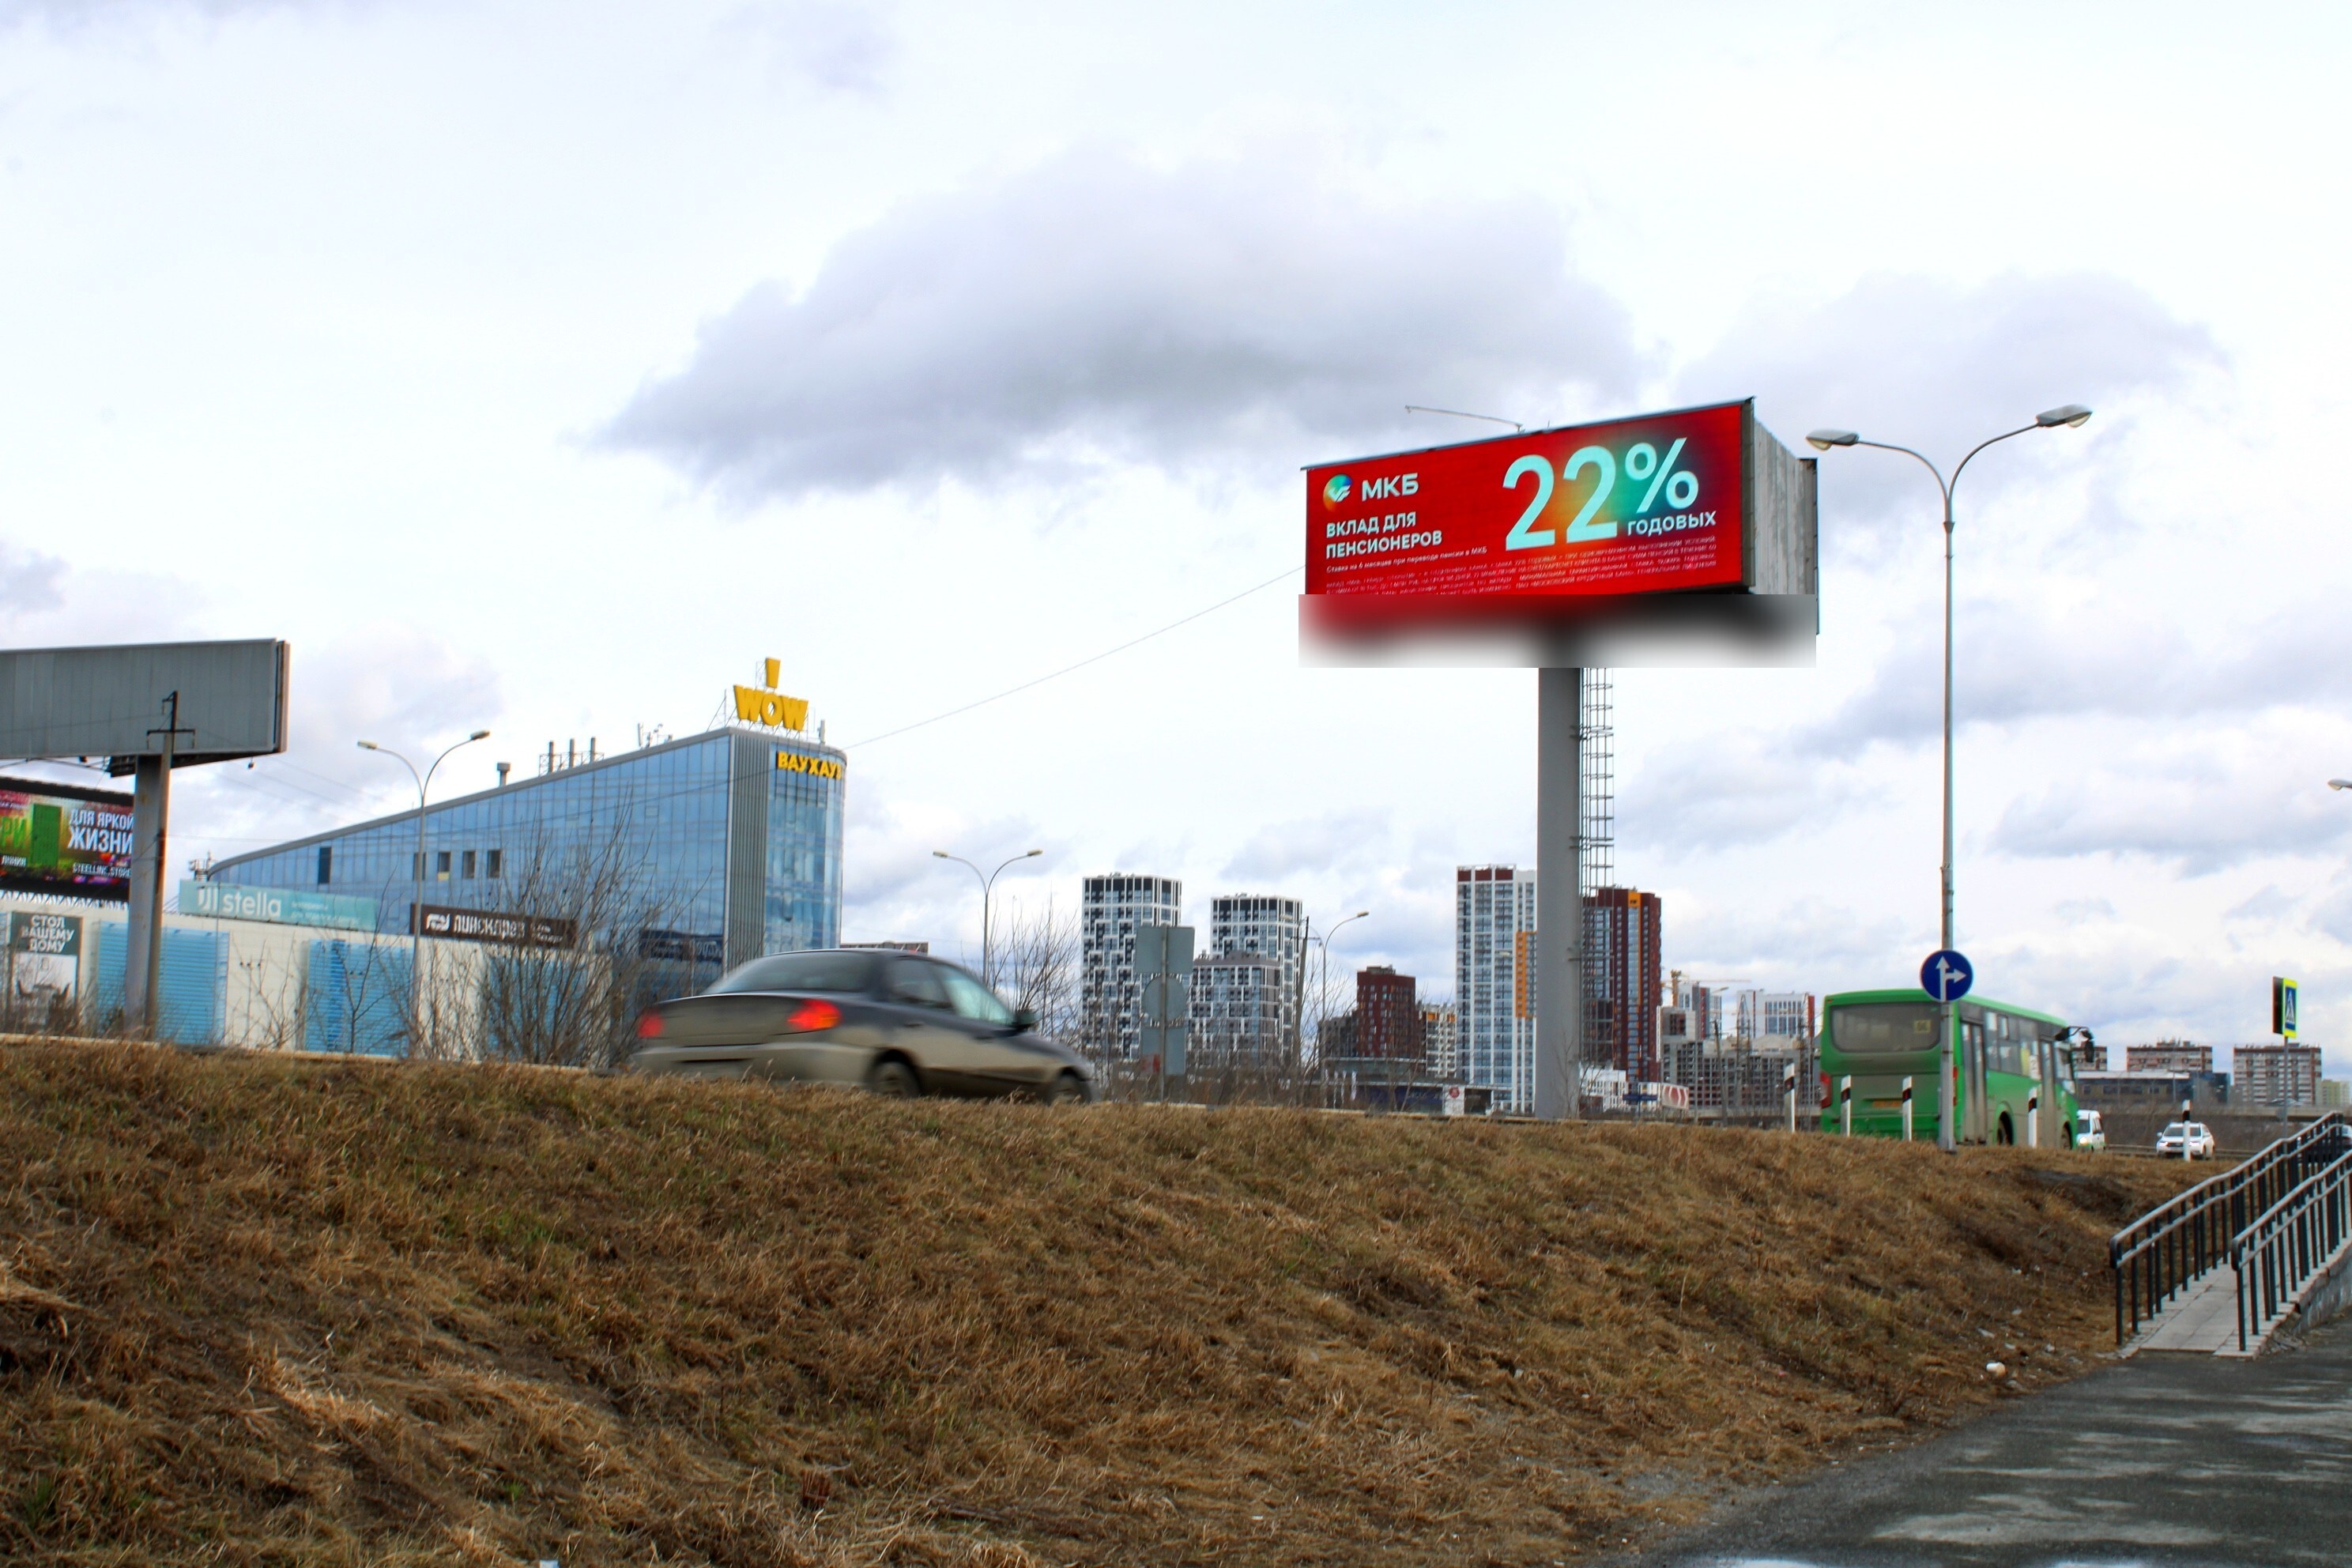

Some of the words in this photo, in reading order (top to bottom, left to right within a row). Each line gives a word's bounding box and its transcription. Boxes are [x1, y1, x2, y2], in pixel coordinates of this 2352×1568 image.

[1361, 472, 1419, 502] МКБ
[1502, 437, 1699, 551] 22%
[1325, 516, 1379, 538] ВКЛАД
[1382, 511, 1417, 533] ДЛЯ
[1626, 510, 1717, 537] ГОДОВЫХ
[1325, 530, 1443, 560] ПЕНСИОНЕРОВ
[733, 684, 808, 732] WOW
[69, 808, 95, 827] ДЛЯ
[97, 812, 134, 830] ЯРКОЙ
[67, 826, 134, 854] ЖИЗНИ
[222, 891, 281, 918] stella
[32, 914, 66, 928] СТОЛ
[28, 938, 66, 953] ДОМУ
